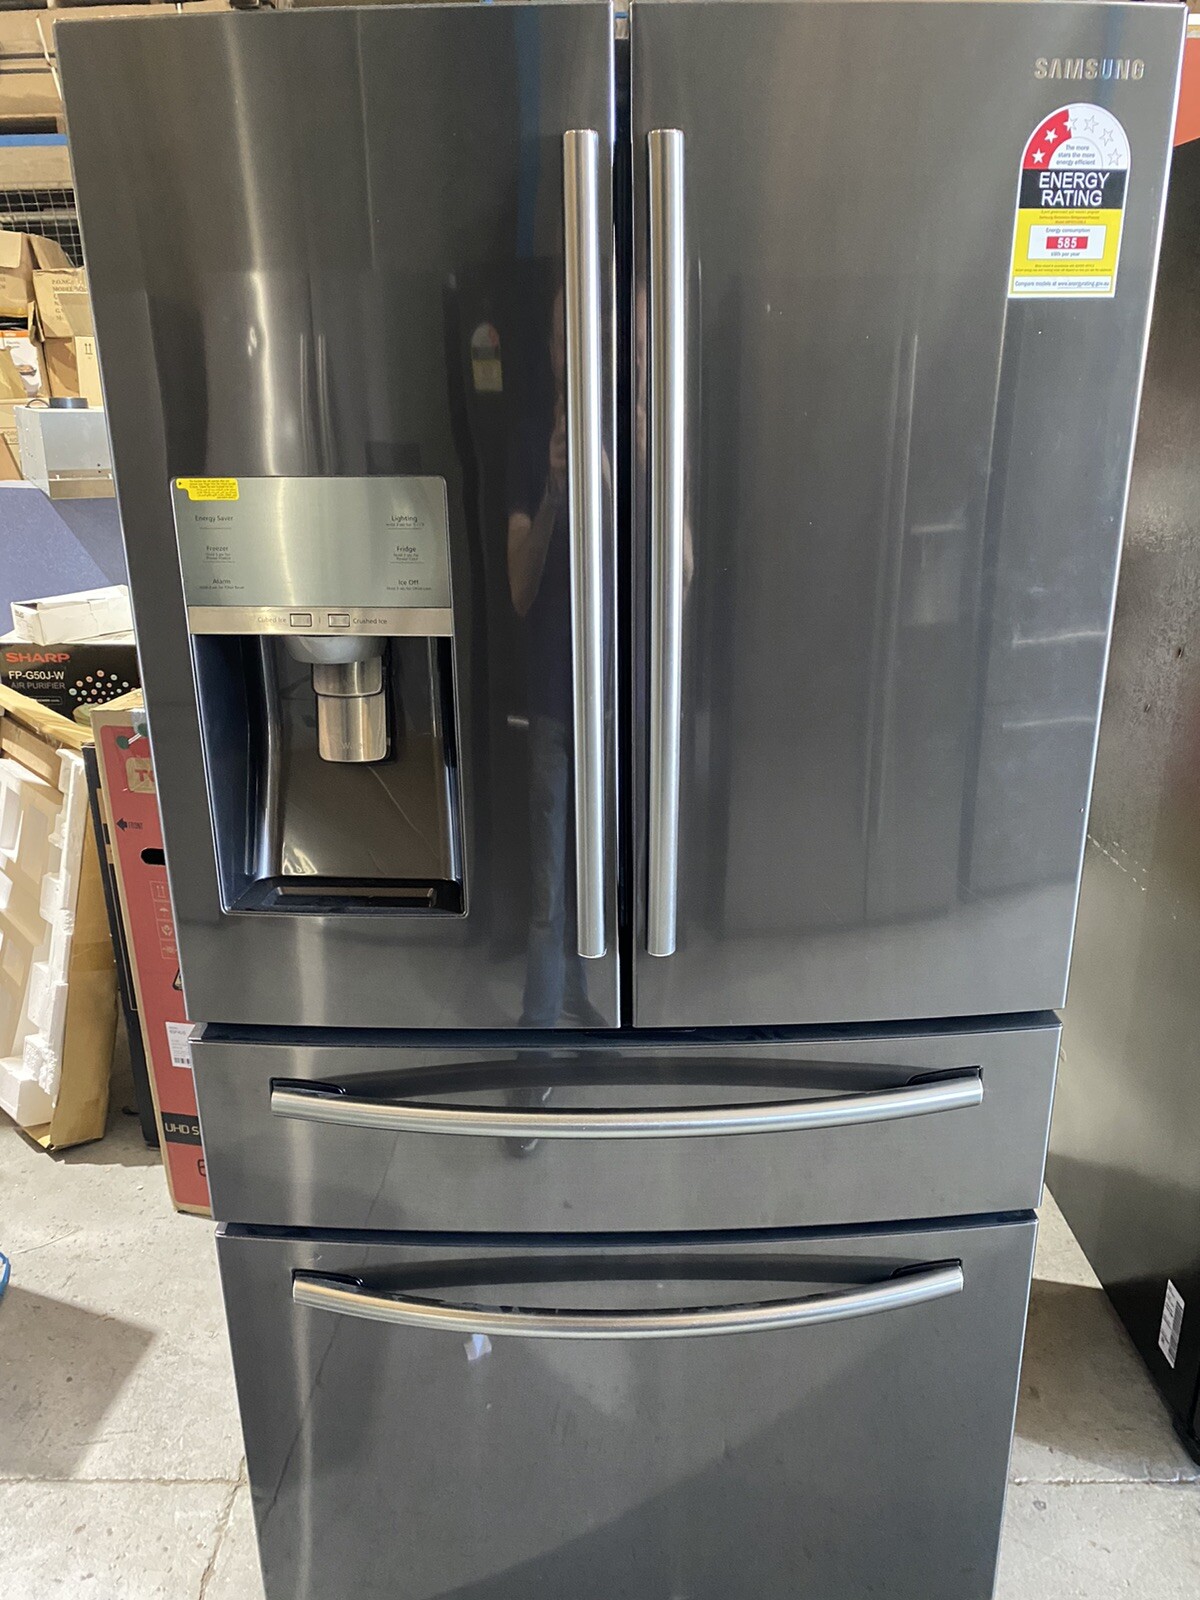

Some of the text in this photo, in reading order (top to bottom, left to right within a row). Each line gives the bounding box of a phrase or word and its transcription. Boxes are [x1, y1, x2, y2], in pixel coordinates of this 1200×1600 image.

[1034, 57, 1144, 80] SAMSUNG
[1039, 171, 1110, 189] ENERGY
[1041, 189, 1103, 206] RATING
[1057, 237, 1077, 248] 585
[5, 652, 70, 663] SHARP
[8, 670, 65, 680] FP-G50J-W
[11, 681, 66, 690] AIR PURIFIER
[165, 1122, 190, 1134] UHD
